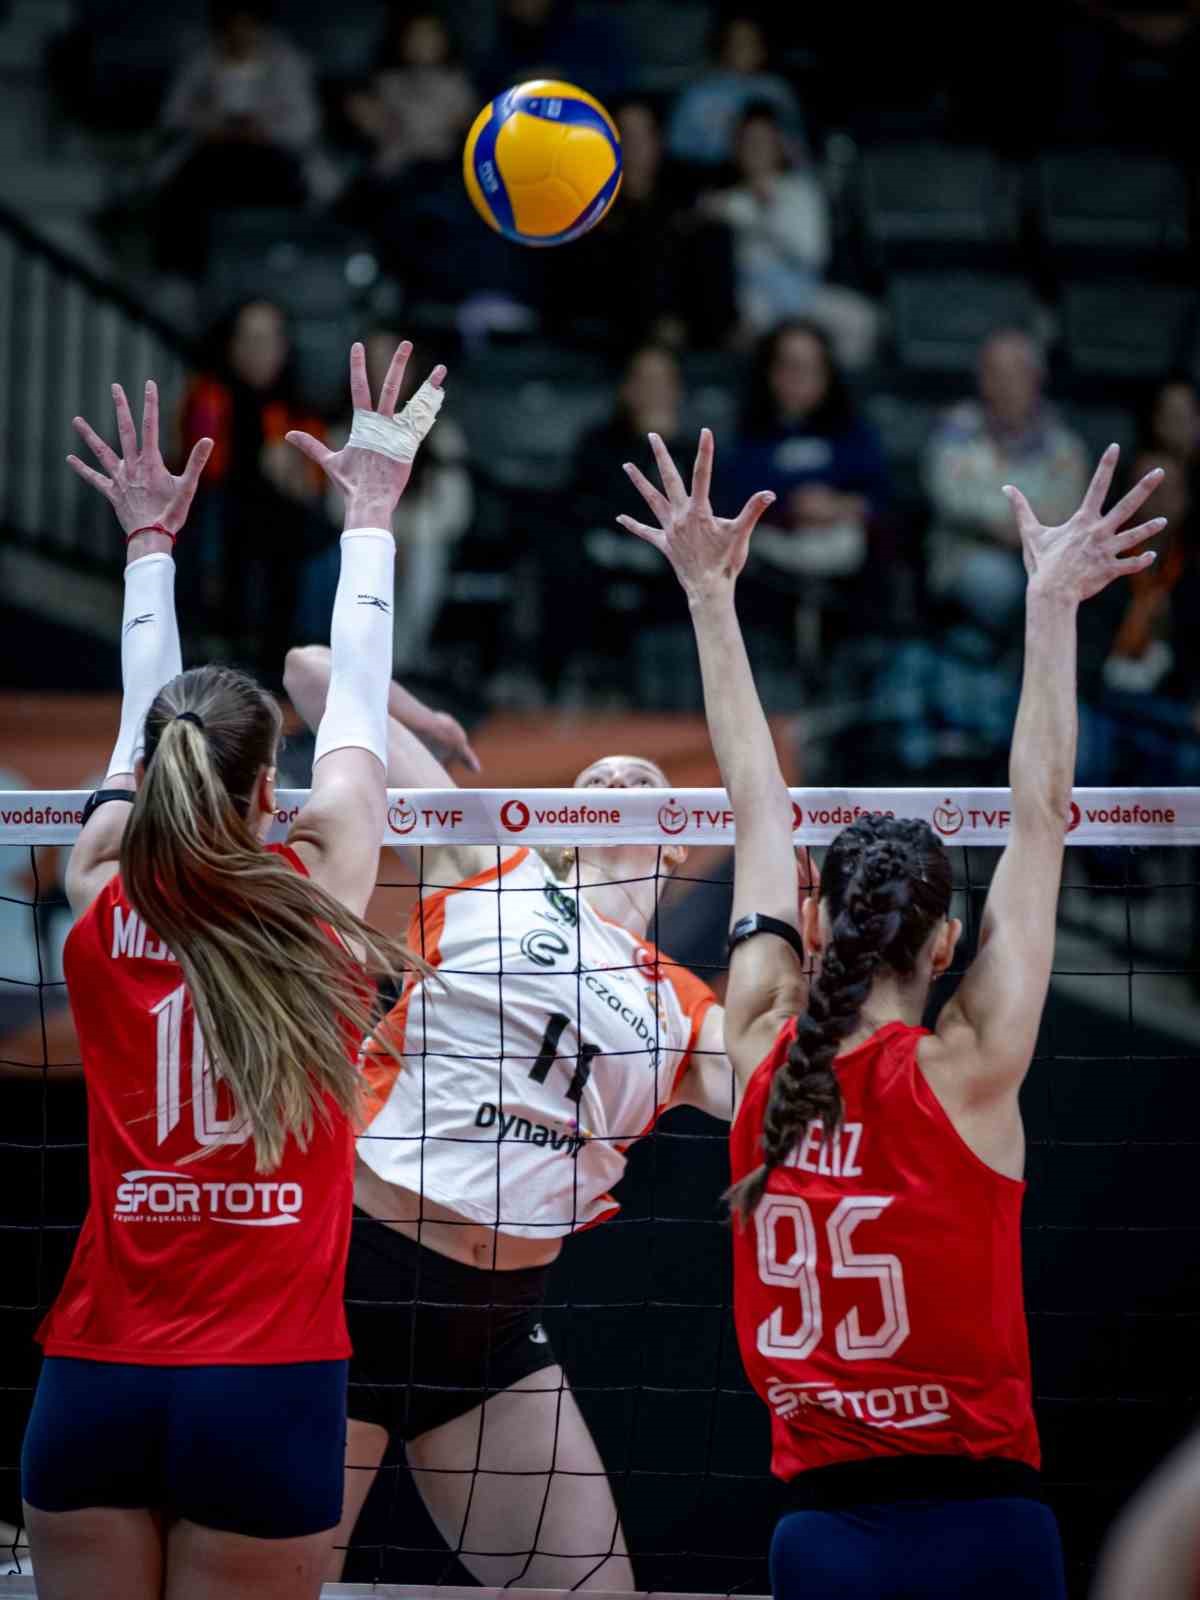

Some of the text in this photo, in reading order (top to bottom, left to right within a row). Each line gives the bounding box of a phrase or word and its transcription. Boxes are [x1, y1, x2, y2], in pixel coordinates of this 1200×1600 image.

[0, 806, 84, 824] vodafone
[421, 809, 463, 828] TVF
[535, 805, 621, 825] vodafone
[692, 810, 734, 828] TVF
[968, 811, 1011, 828] TVF
[1086, 804, 1175, 823] vodafone
[528, 1012, 602, 1103] 11
[754, 1193, 910, 1360] 95
